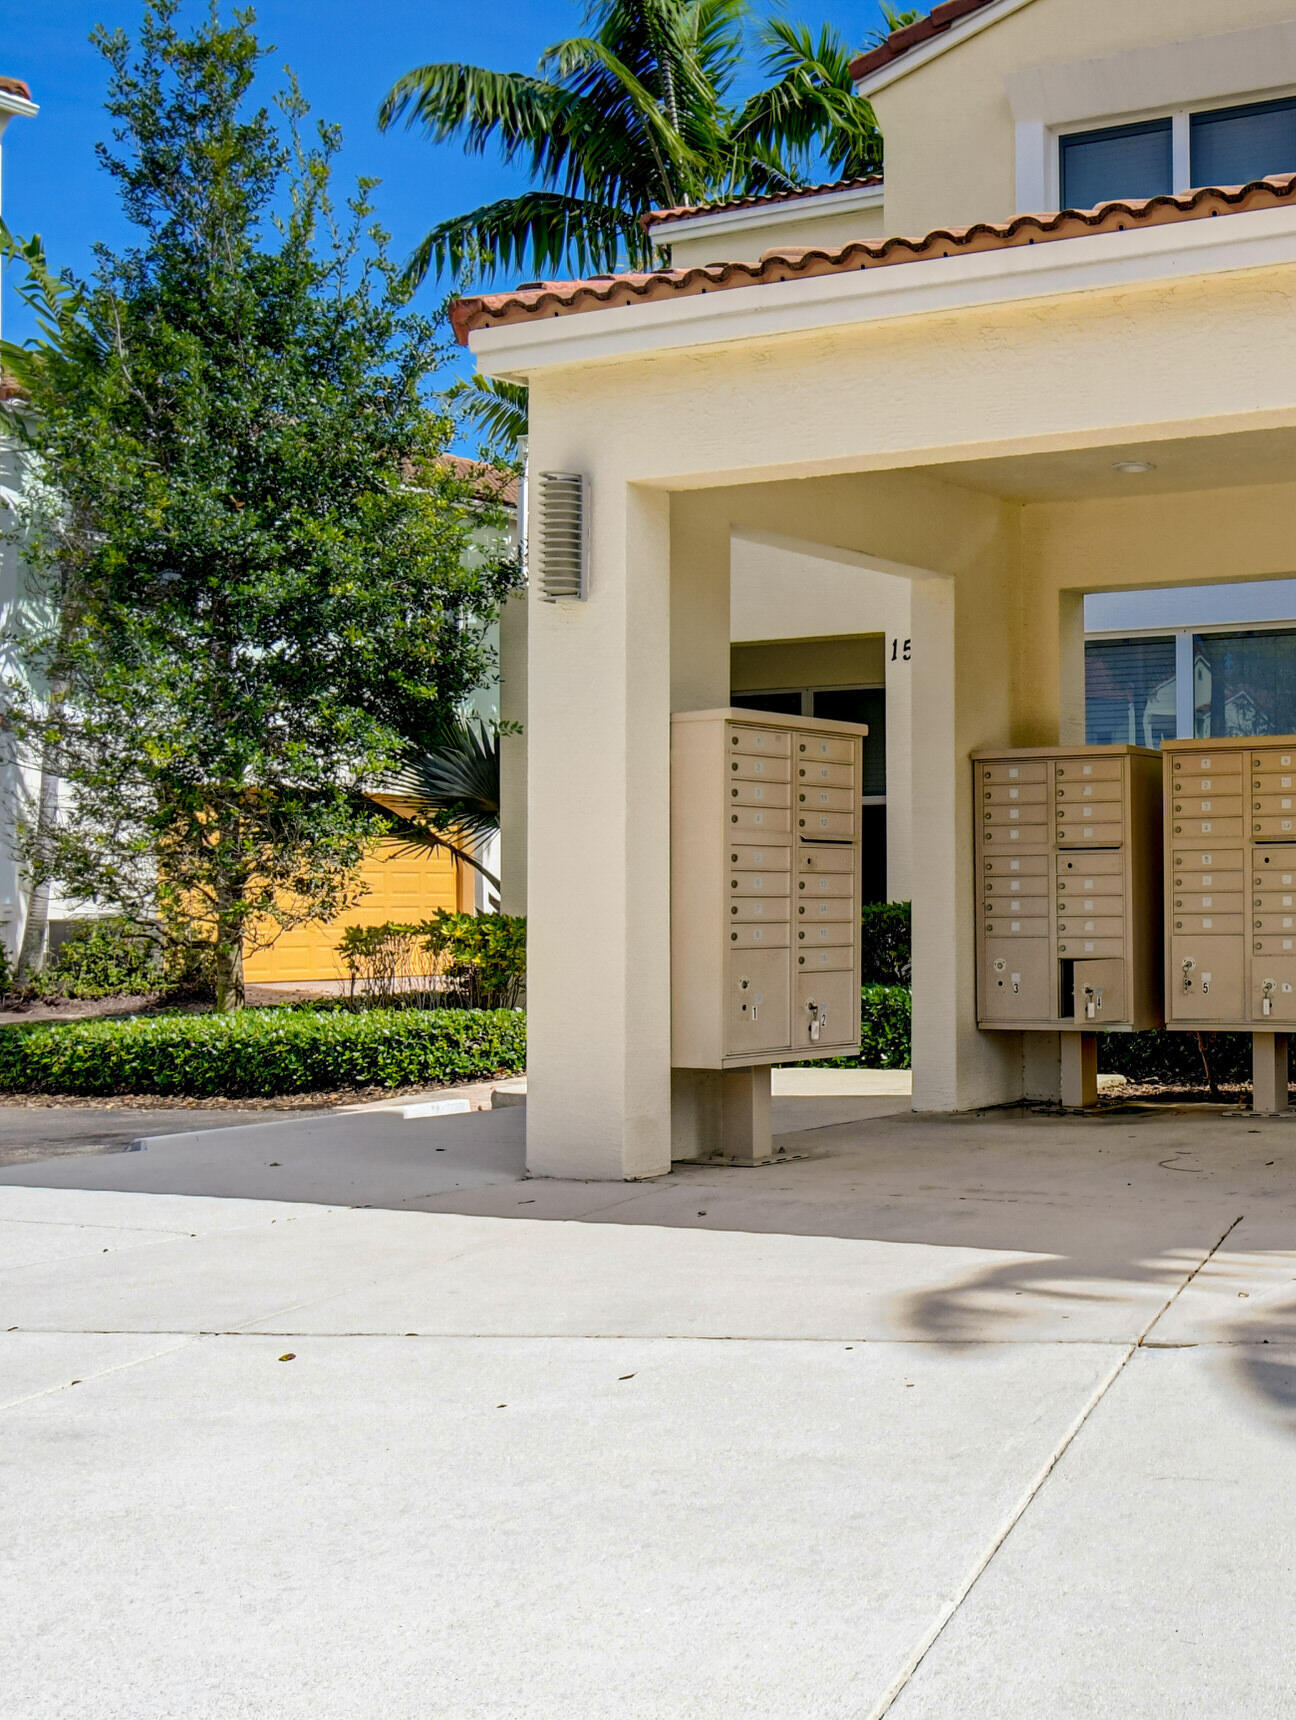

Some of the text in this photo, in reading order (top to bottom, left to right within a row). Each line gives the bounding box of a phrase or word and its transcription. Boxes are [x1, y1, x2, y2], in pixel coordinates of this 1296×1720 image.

[1013, 983, 1019, 994] 3
[1202, 982, 1209, 994] 5
[753, 1006, 757, 1019] 1
[821, 1013, 827, 1027] 2
